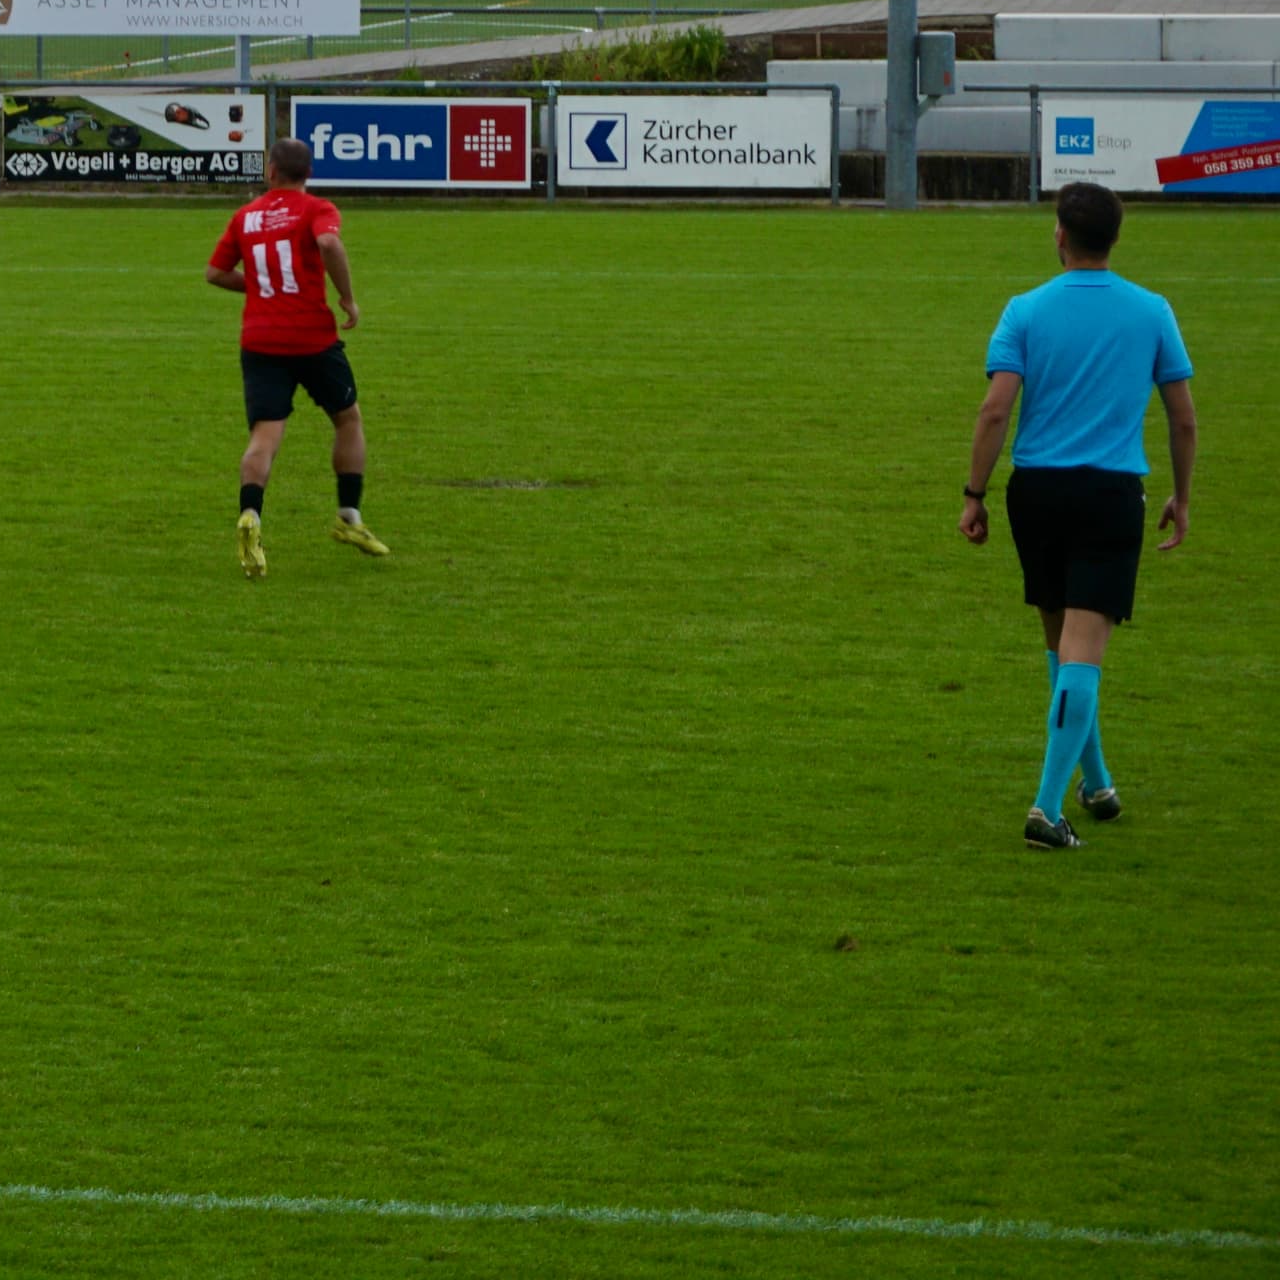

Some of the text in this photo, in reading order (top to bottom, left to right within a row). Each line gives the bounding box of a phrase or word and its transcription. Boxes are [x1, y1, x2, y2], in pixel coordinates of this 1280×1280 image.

[642, 118, 738, 141] Zürcher
[1059, 134, 1090, 148] EKZ
[309, 122, 433, 162] fehr
[642, 141, 817, 166] Kantonalbank
[1096, 135, 1132, 151] Eltop
[51, 151, 240, 176] Vögeli + Berger AG
[1203, 161, 1228, 175] 058
[1231, 157, 1254, 171] 359
[1256, 154, 1273, 167] 48
[252, 239, 300, 299] 11
